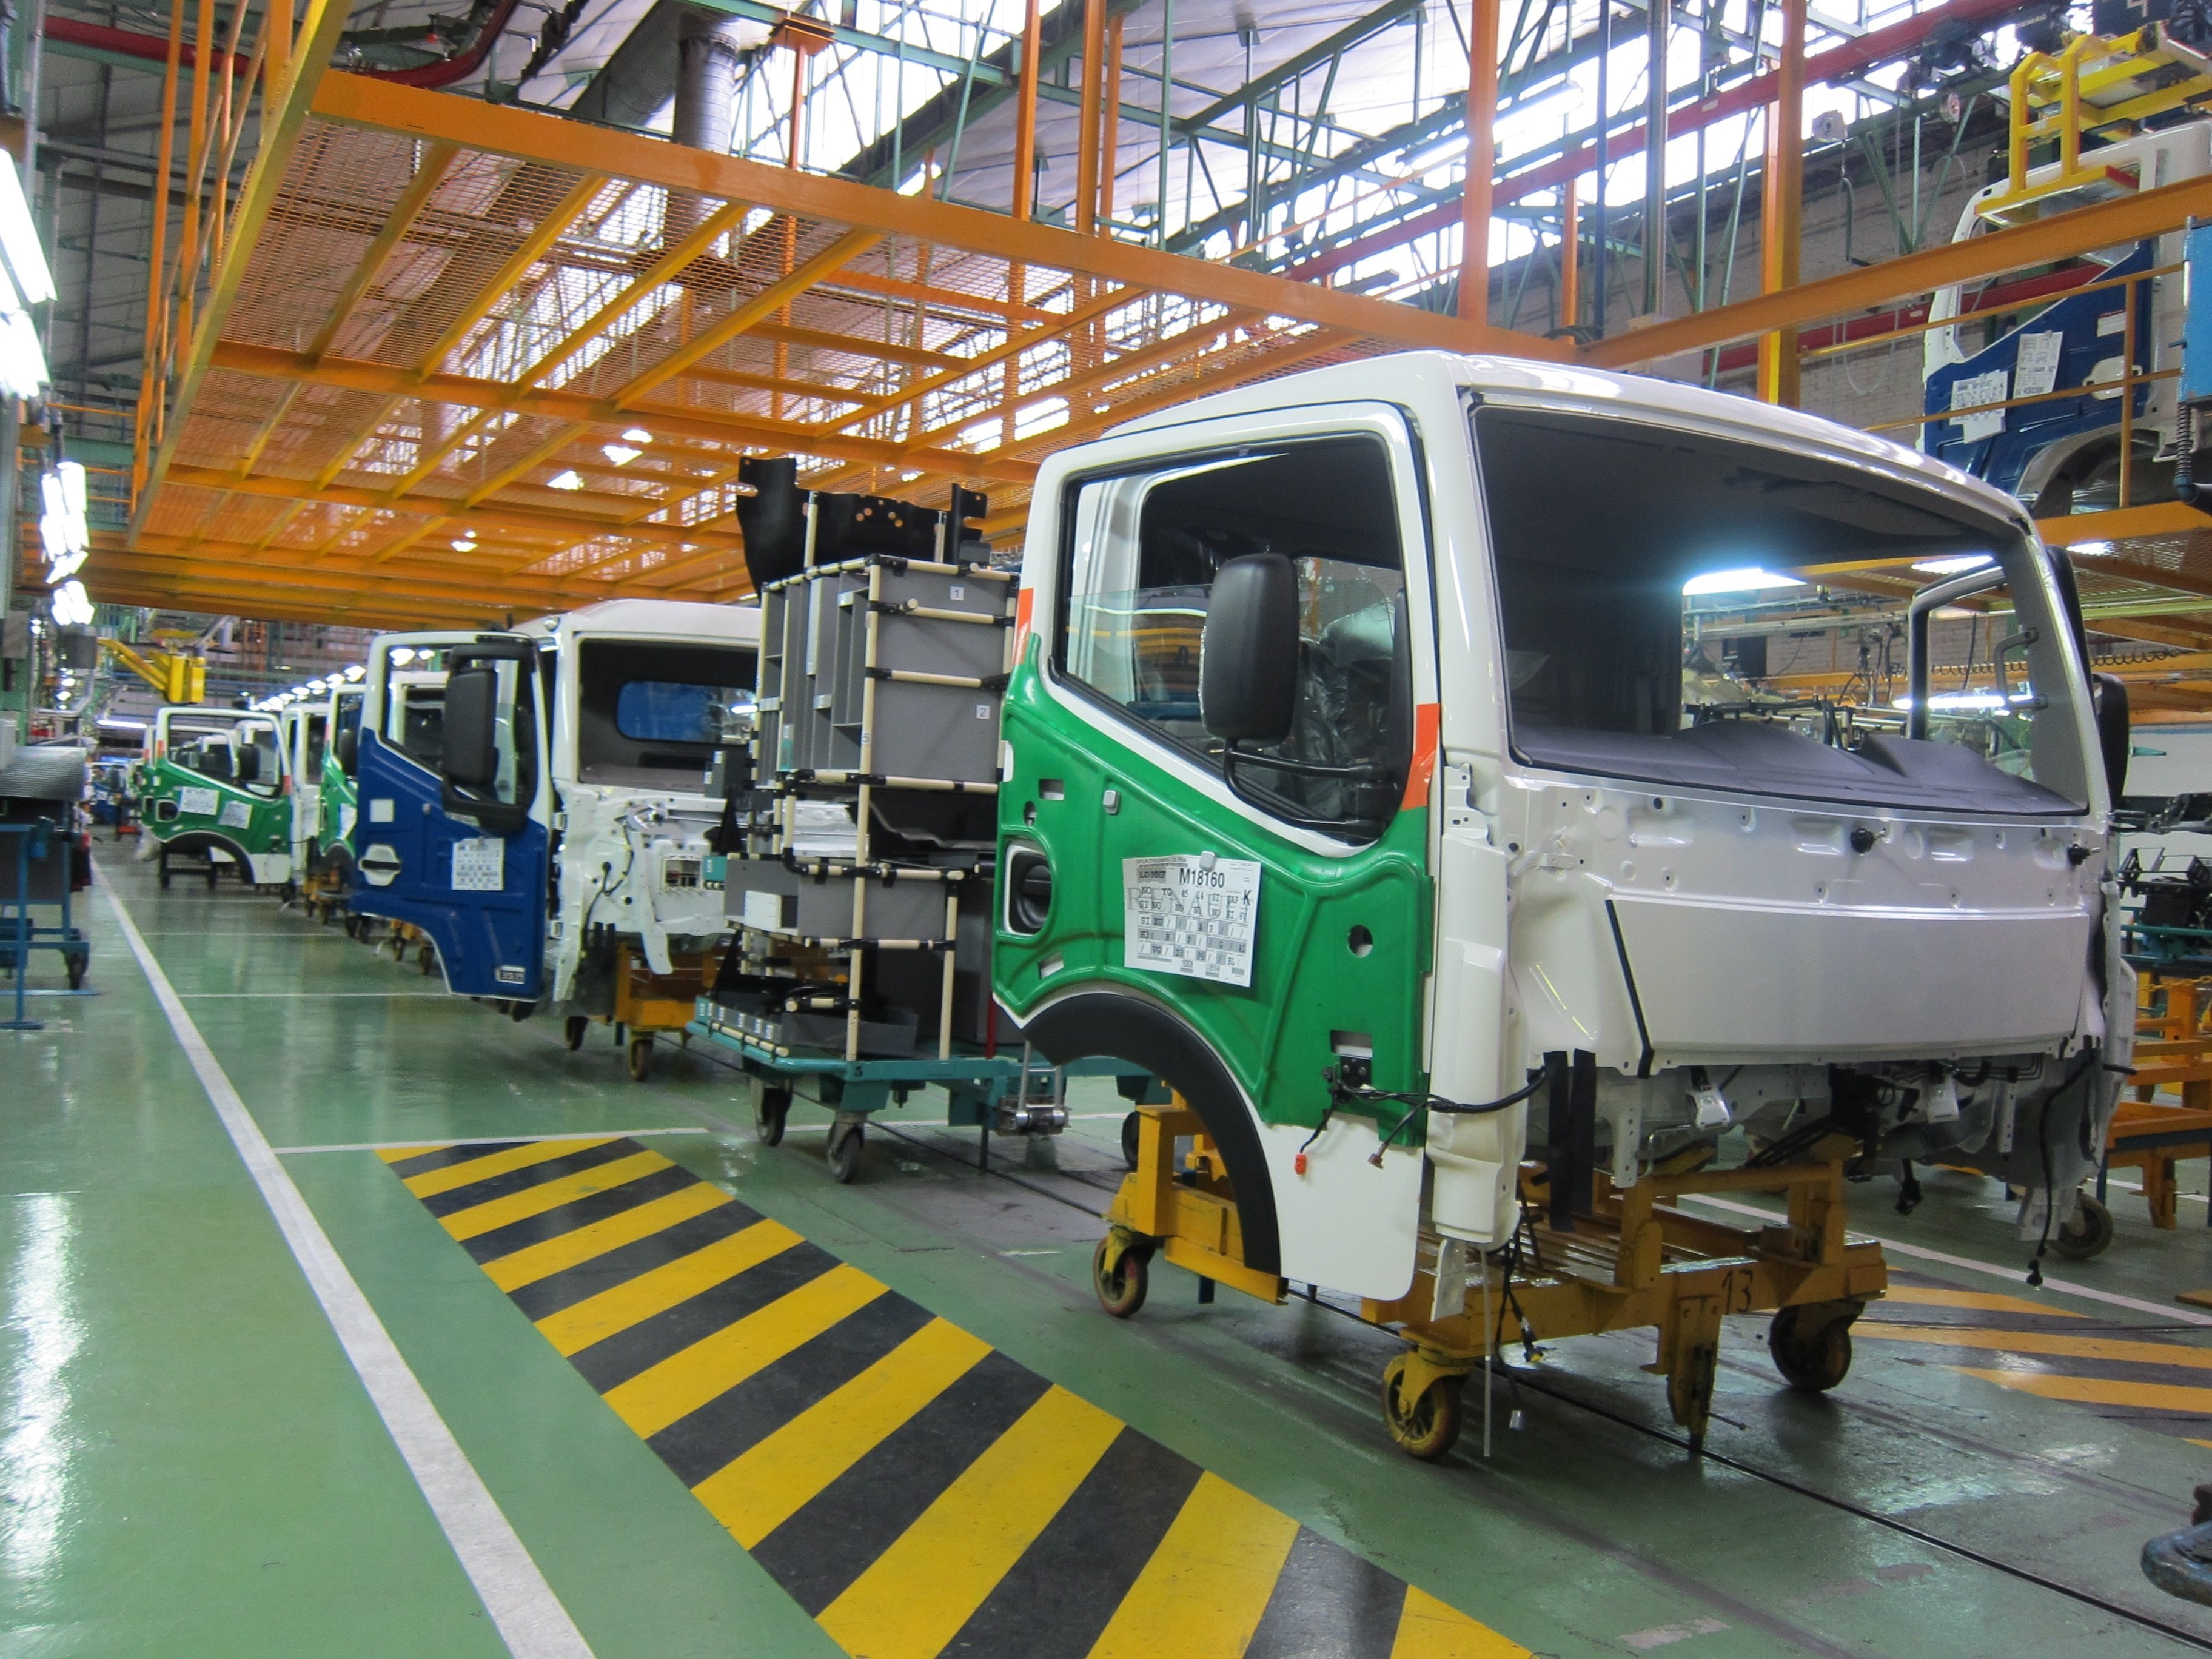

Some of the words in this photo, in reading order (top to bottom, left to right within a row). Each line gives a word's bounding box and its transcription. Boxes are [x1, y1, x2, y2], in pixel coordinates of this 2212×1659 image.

[979, 707, 986, 717] 2
[1179, 868, 1225, 888] M18160
[1243, 889, 1252, 906] K
[1721, 1268, 1754, 1316] 13
